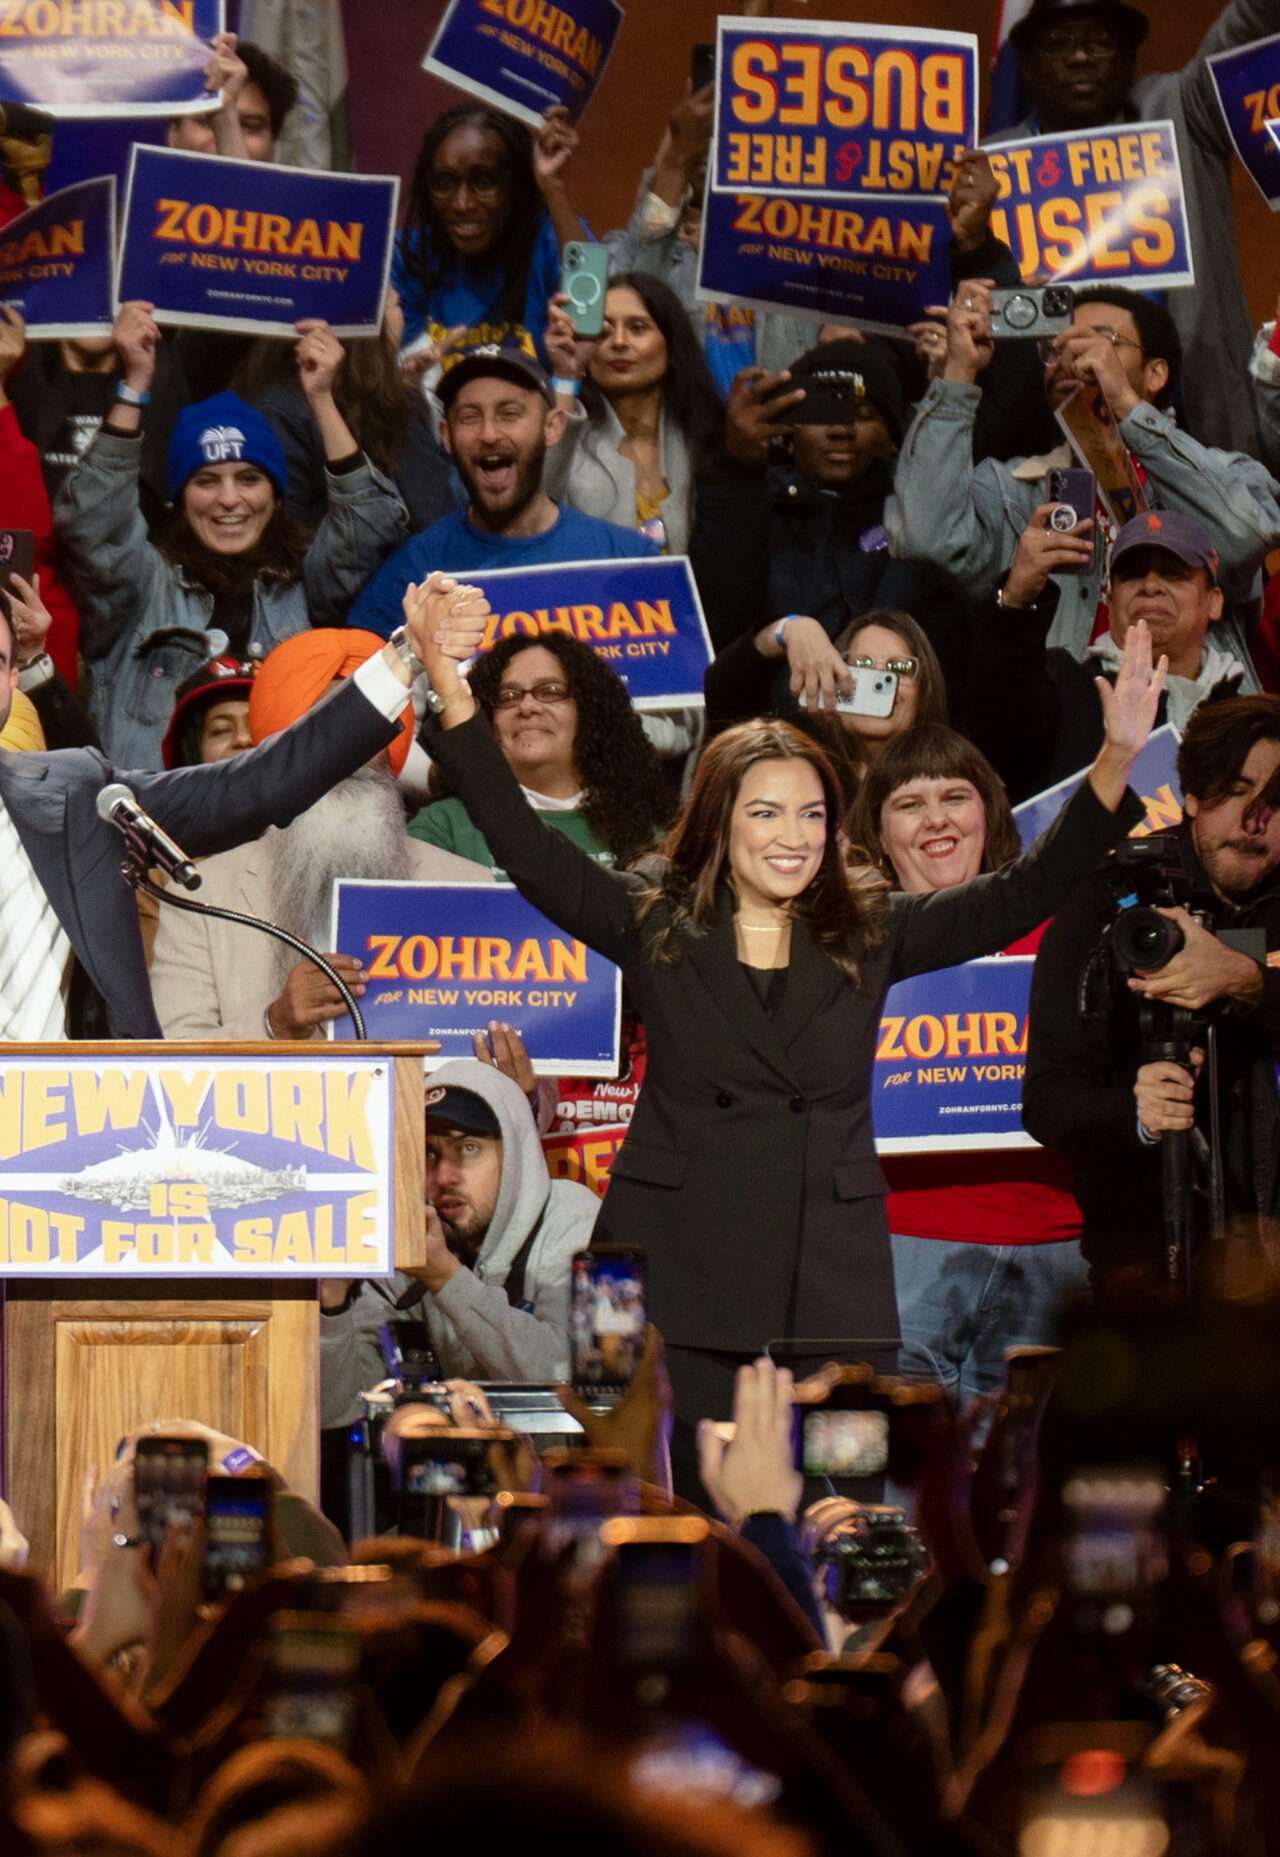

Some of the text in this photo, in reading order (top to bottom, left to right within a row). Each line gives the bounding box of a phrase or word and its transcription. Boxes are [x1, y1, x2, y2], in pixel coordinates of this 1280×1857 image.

[731, 39, 966, 135] BUSES
[726, 132, 827, 187] FREE
[987, 149, 1034, 201] ST
[1066, 132, 1168, 188] FREE
[154, 198, 364, 262] ZOHRAN
[733, 195, 934, 264] ZOHRAN
[28, 262, 76, 279] CITY
[190, 252, 239, 272] NEW
[242, 259, 297, 279] YORK
[301, 265, 349, 284] CITY
[768, 245, 814, 266] NEW
[818, 253, 867, 276] YORK
[872, 264, 917, 284] CITY
[205, 442, 243, 461] UFT
[594, 641, 670, 659] RK CITY
[367, 935, 589, 983] ZOHRAN
[373, 989, 577, 1008] FOR NEW YORK CITY
[883, 1064, 1026, 1089] FOR NEW YORK
[160, 1069, 378, 1173] YORK
[938, 1103, 1024, 1115] ZOHRANFORNYC.CO
[150, 1182, 208, 1217] IS
[102, 1220, 216, 1264] FOR
[233, 1189, 379, 1264] SALE
